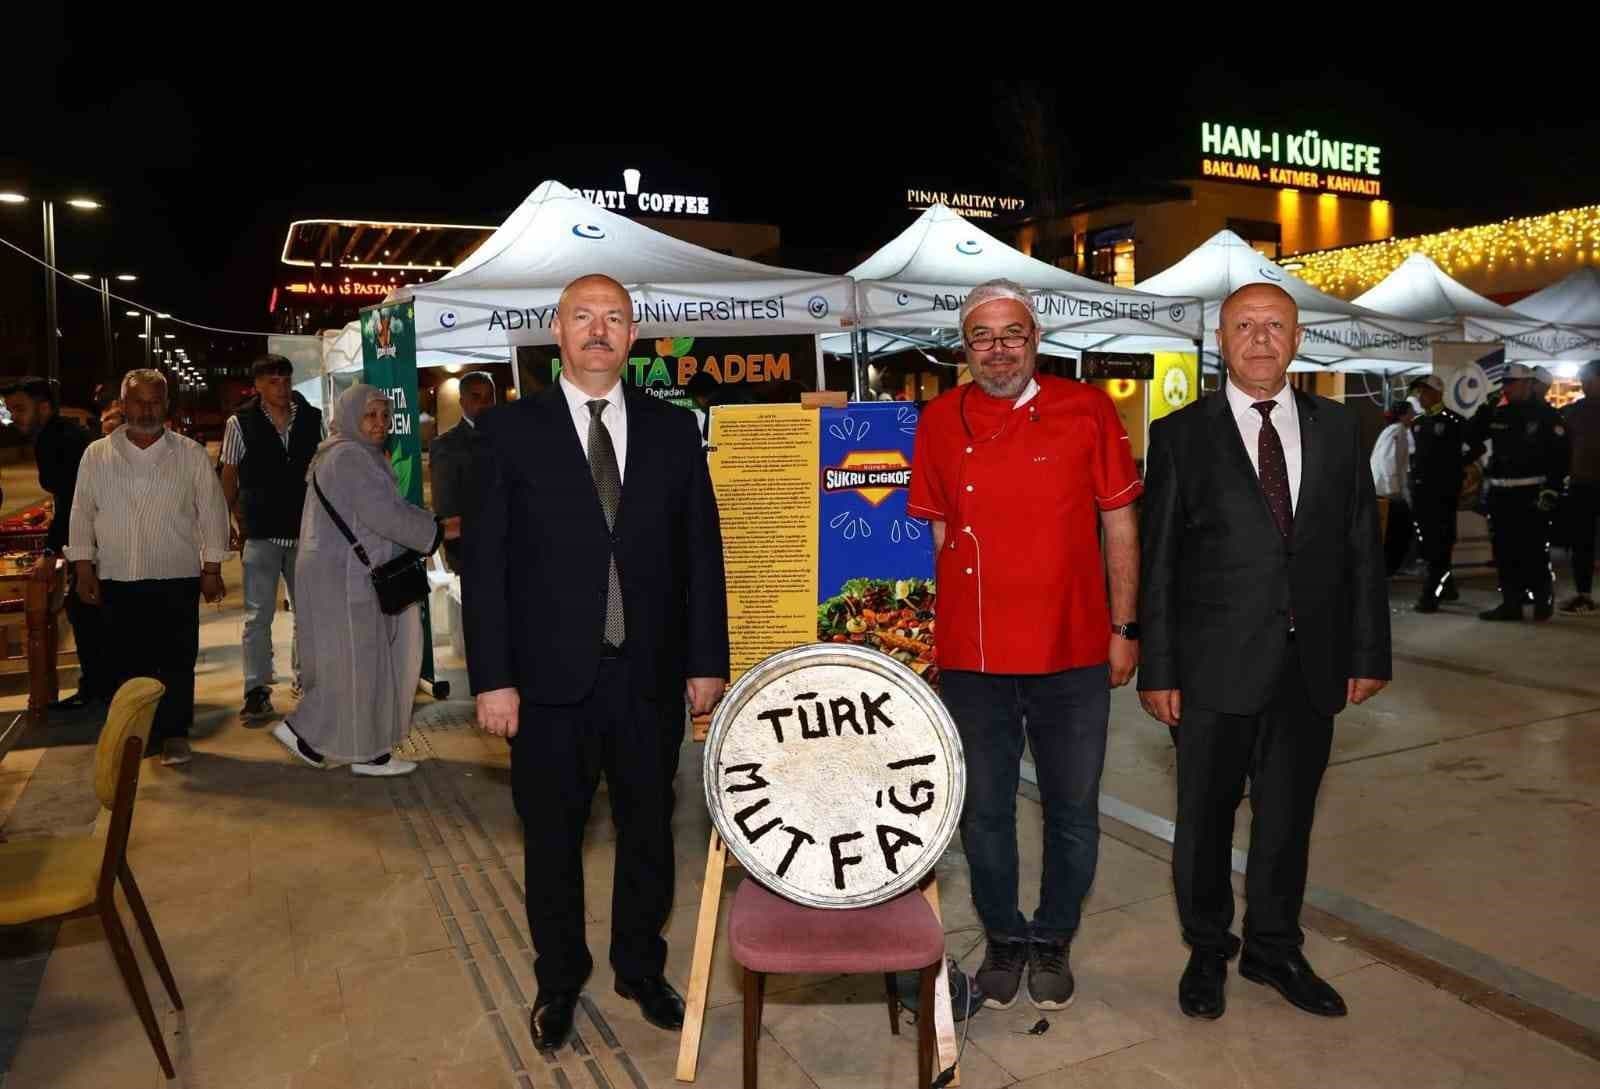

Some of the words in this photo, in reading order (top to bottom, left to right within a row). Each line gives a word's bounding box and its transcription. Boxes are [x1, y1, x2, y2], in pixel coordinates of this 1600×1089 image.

[1286, 129, 1381, 176] KÜNEFE
[1202, 159, 1262, 182] BAKLAVA
[1269, 167, 1319, 189] KATMER
[1326, 174, 1381, 196] KAHVALTI
[638, 192, 710, 215] COFFEE
[354, 282, 396, 295] PASTAN
[757, 691, 896, 743] TÜRK
